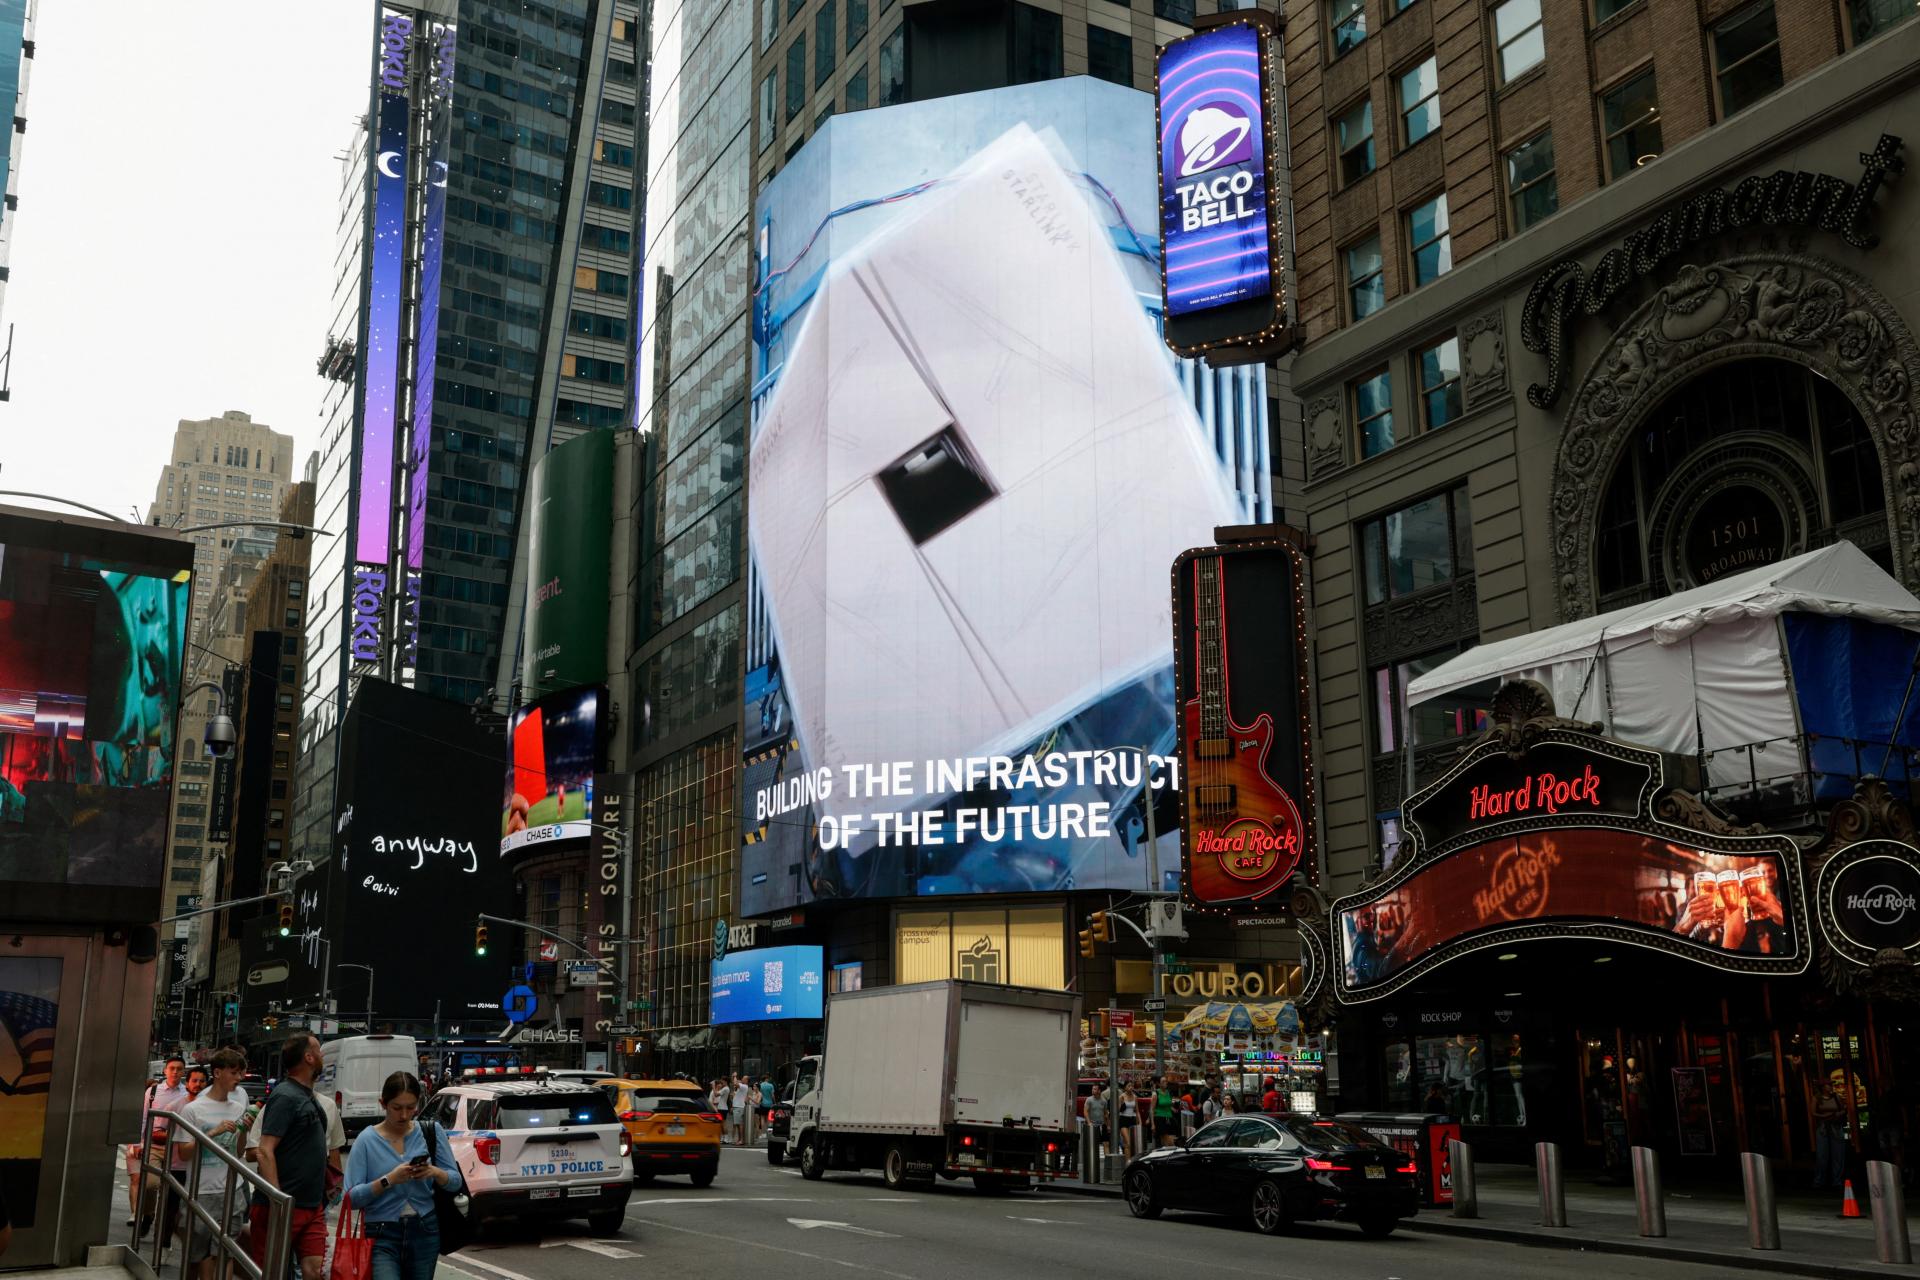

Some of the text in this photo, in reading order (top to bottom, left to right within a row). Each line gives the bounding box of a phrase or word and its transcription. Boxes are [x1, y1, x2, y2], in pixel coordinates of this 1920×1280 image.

[1176, 170, 1253, 208] TACO
[1183, 196, 1254, 232] BELL
[1712, 516, 1760, 547] 1501
[1702, 548, 1776, 581] BROADWAY
[757, 766, 832, 822] BUILDING
[841, 761, 913, 798] THE
[1470, 765, 1600, 819] Hard Rock
[526, 827, 552, 842] CHASE
[819, 802, 1111, 850] OF THE FUTURE
[371, 835, 477, 873] anyway
[601, 795, 620, 896] SQUARE
[1196, 829, 1297, 855] Hard Rock
[1233, 858, 1263, 867] CAFE
[1472, 836, 1561, 923] Hard Rock
[1847, 893, 1916, 911] Hard Rock
[727, 922, 758, 950] AT&T
[1237, 918, 1286, 926] SPECTACOLOR
[597, 923, 616, 1002] TIMES
[1161, 972, 1264, 998] TOURO
[595, 1019, 612, 1032] 3
[1421, 1011, 1462, 1023] ROCK SHOP
[518, 1029, 580, 1043] CHASE
[1822, 1041, 1859, 1049] MESI
[521, 1160, 604, 1177] NYPD POLICE
